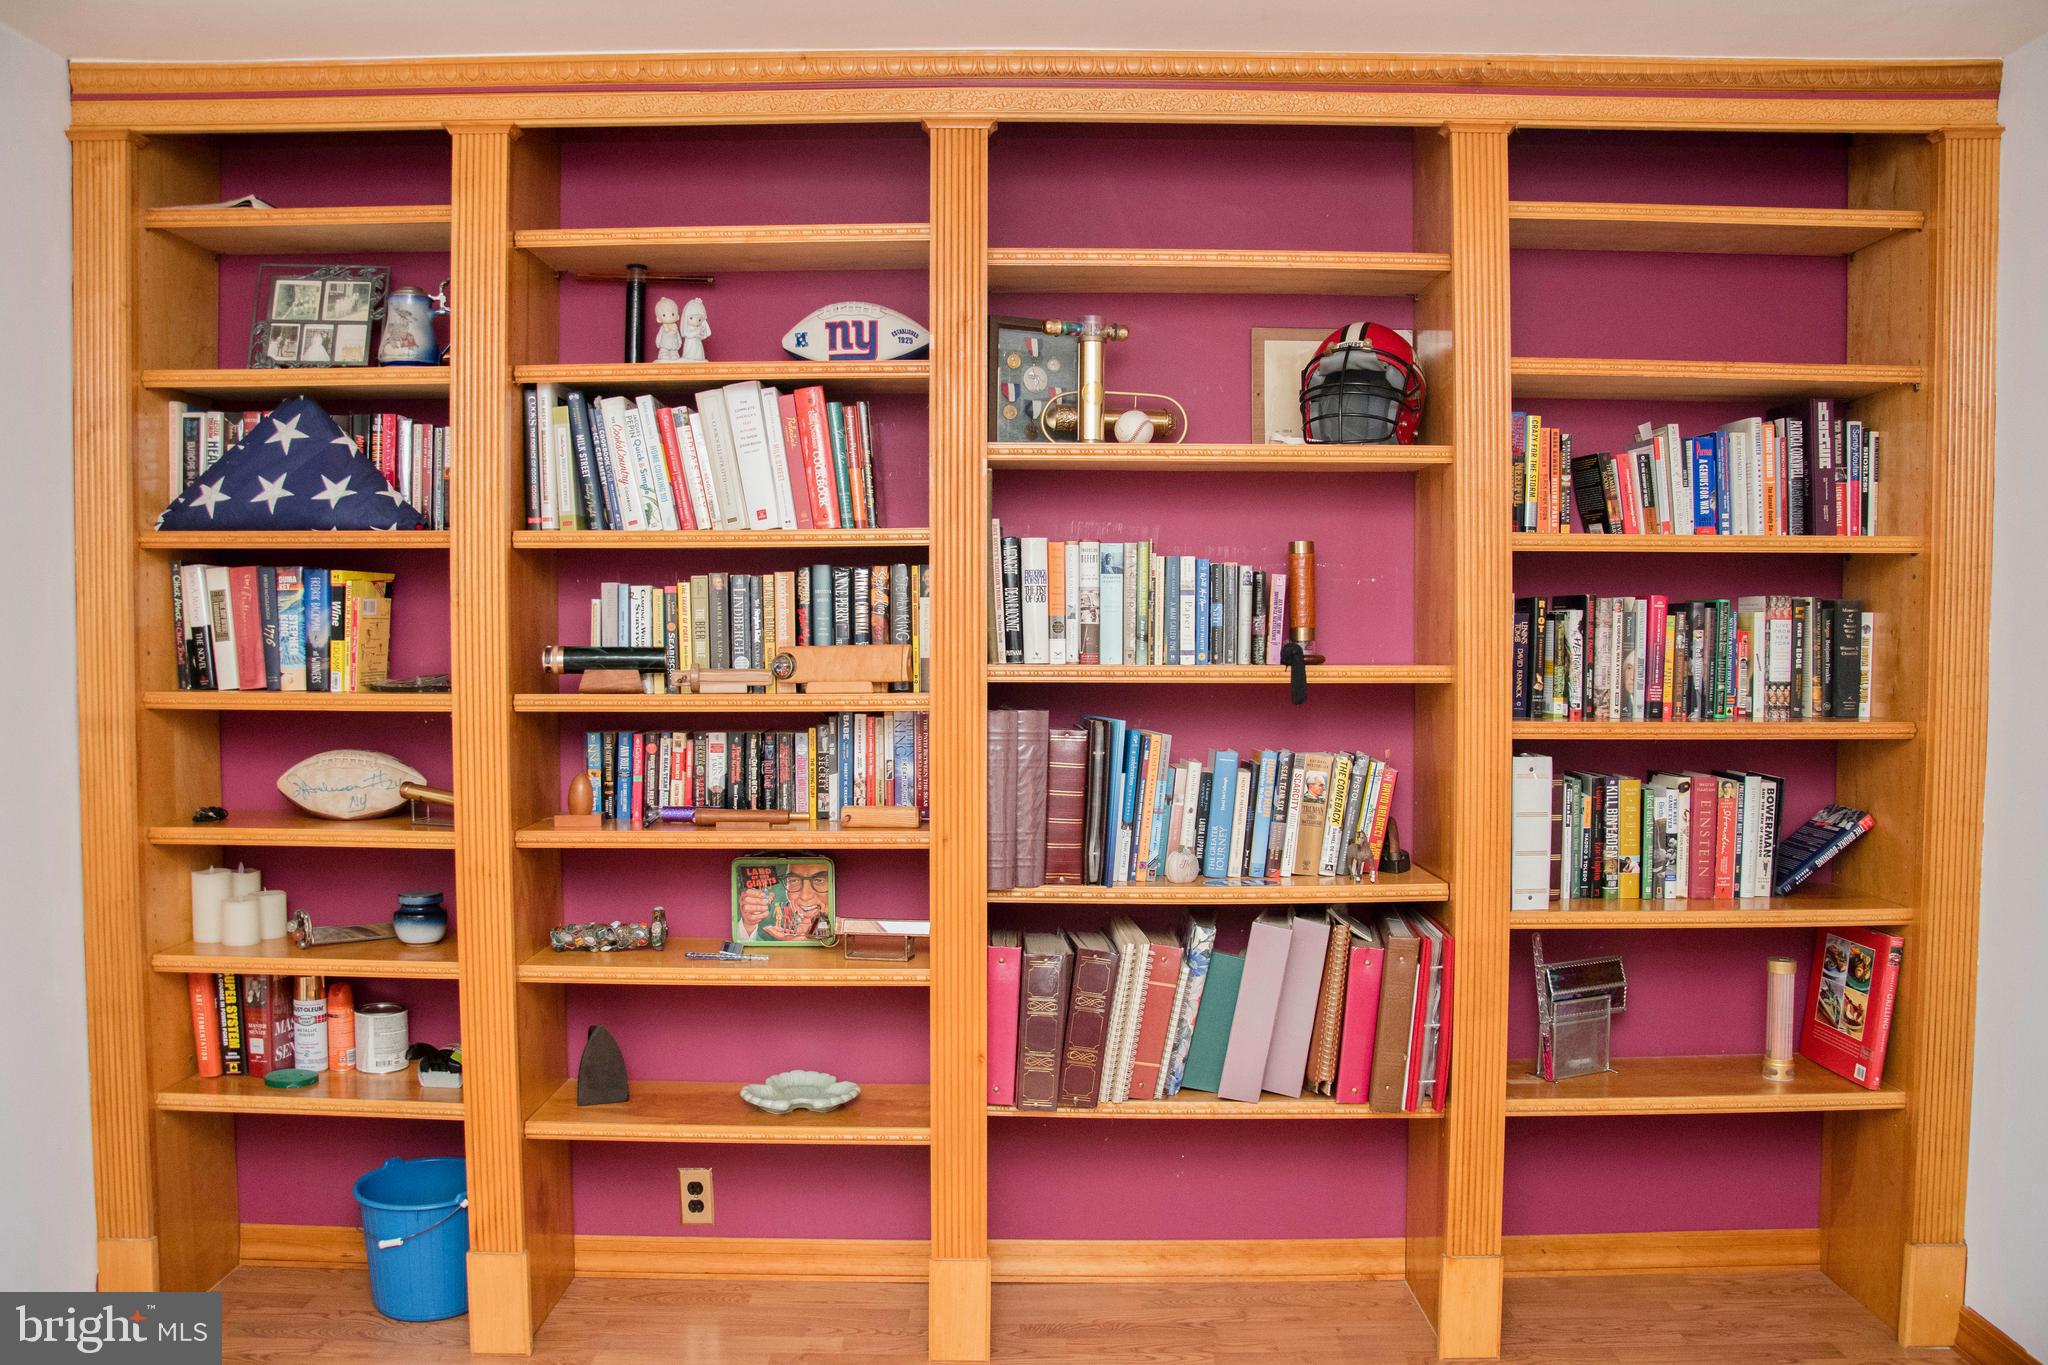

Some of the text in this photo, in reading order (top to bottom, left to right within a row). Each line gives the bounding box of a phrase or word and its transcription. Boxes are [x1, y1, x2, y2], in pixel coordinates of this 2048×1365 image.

[576, 435, 590, 477] MILK STREET
[594, 446, 607, 485] CREAMERY
[599, 430, 609, 465] COOKBOOK
[634, 439, 644, 463] Quick
[640, 468, 650, 494] Simple
[1790, 420, 1803, 479] PATRICIA CORNWELL
[650, 445, 658, 463] HOME
[655, 464, 665, 492] COOKING
[812, 451, 829, 508] COOKBOOK
[1699, 464, 1708, 486] GENIUS
[1700, 487, 1708, 499] FOR
[1701, 501, 1709, 514] WAR
[1791, 481, 1803, 506] BLACK
[1004, 545, 1017, 574] MIDNIGHT
[310, 577, 321, 631] FREDRIK BACKMAN
[332, 601, 341, 626] Wine
[835, 571, 849, 623] ANNE PERRY
[855, 570, 868, 634] PATRICIA CORNWELL
[1185, 601, 1194, 629] Paper
[264, 624, 275, 648] 1776
[280, 615, 299, 656] STEPHEN KING
[696, 621, 706, 639] BEER
[733, 588, 746, 655] LINDBERGH
[896, 614, 910, 641] KING
[1006, 609, 1019, 632] KOONTZ
[198, 648, 207, 670] NOVEL
[311, 657, 321, 683] WINNERS
[618, 746, 630, 757] ANN
[894, 720, 906, 756] KING
[1277, 799, 1285, 811] SIX
[1279, 782, 1287, 798] TEAM
[1291, 773, 1302, 811] SCARCITY
[1332, 762, 1348, 824] THE COMEBACK
[1373, 783, 1392, 837] DAVID BALDACCI
[1606, 785, 1618, 858] KILL BIN LADEN
[1764, 788, 1775, 858] BOWERMAN
[1196, 818, 1207, 859] LAURA LIPPMAN
[1217, 826, 1228, 871] JOURNEY
[1647, 826, 1652, 838] Me
[1698, 800, 1711, 877] EINSTEIN
[1721, 809, 1730, 855] Houdini
[1814, 846, 1838, 868] BURNING
[746, 877, 776, 889] GIANTS
[198, 1013, 207, 1060] FERMENTATION
[226, 1006, 240, 1048] SYSTEM
